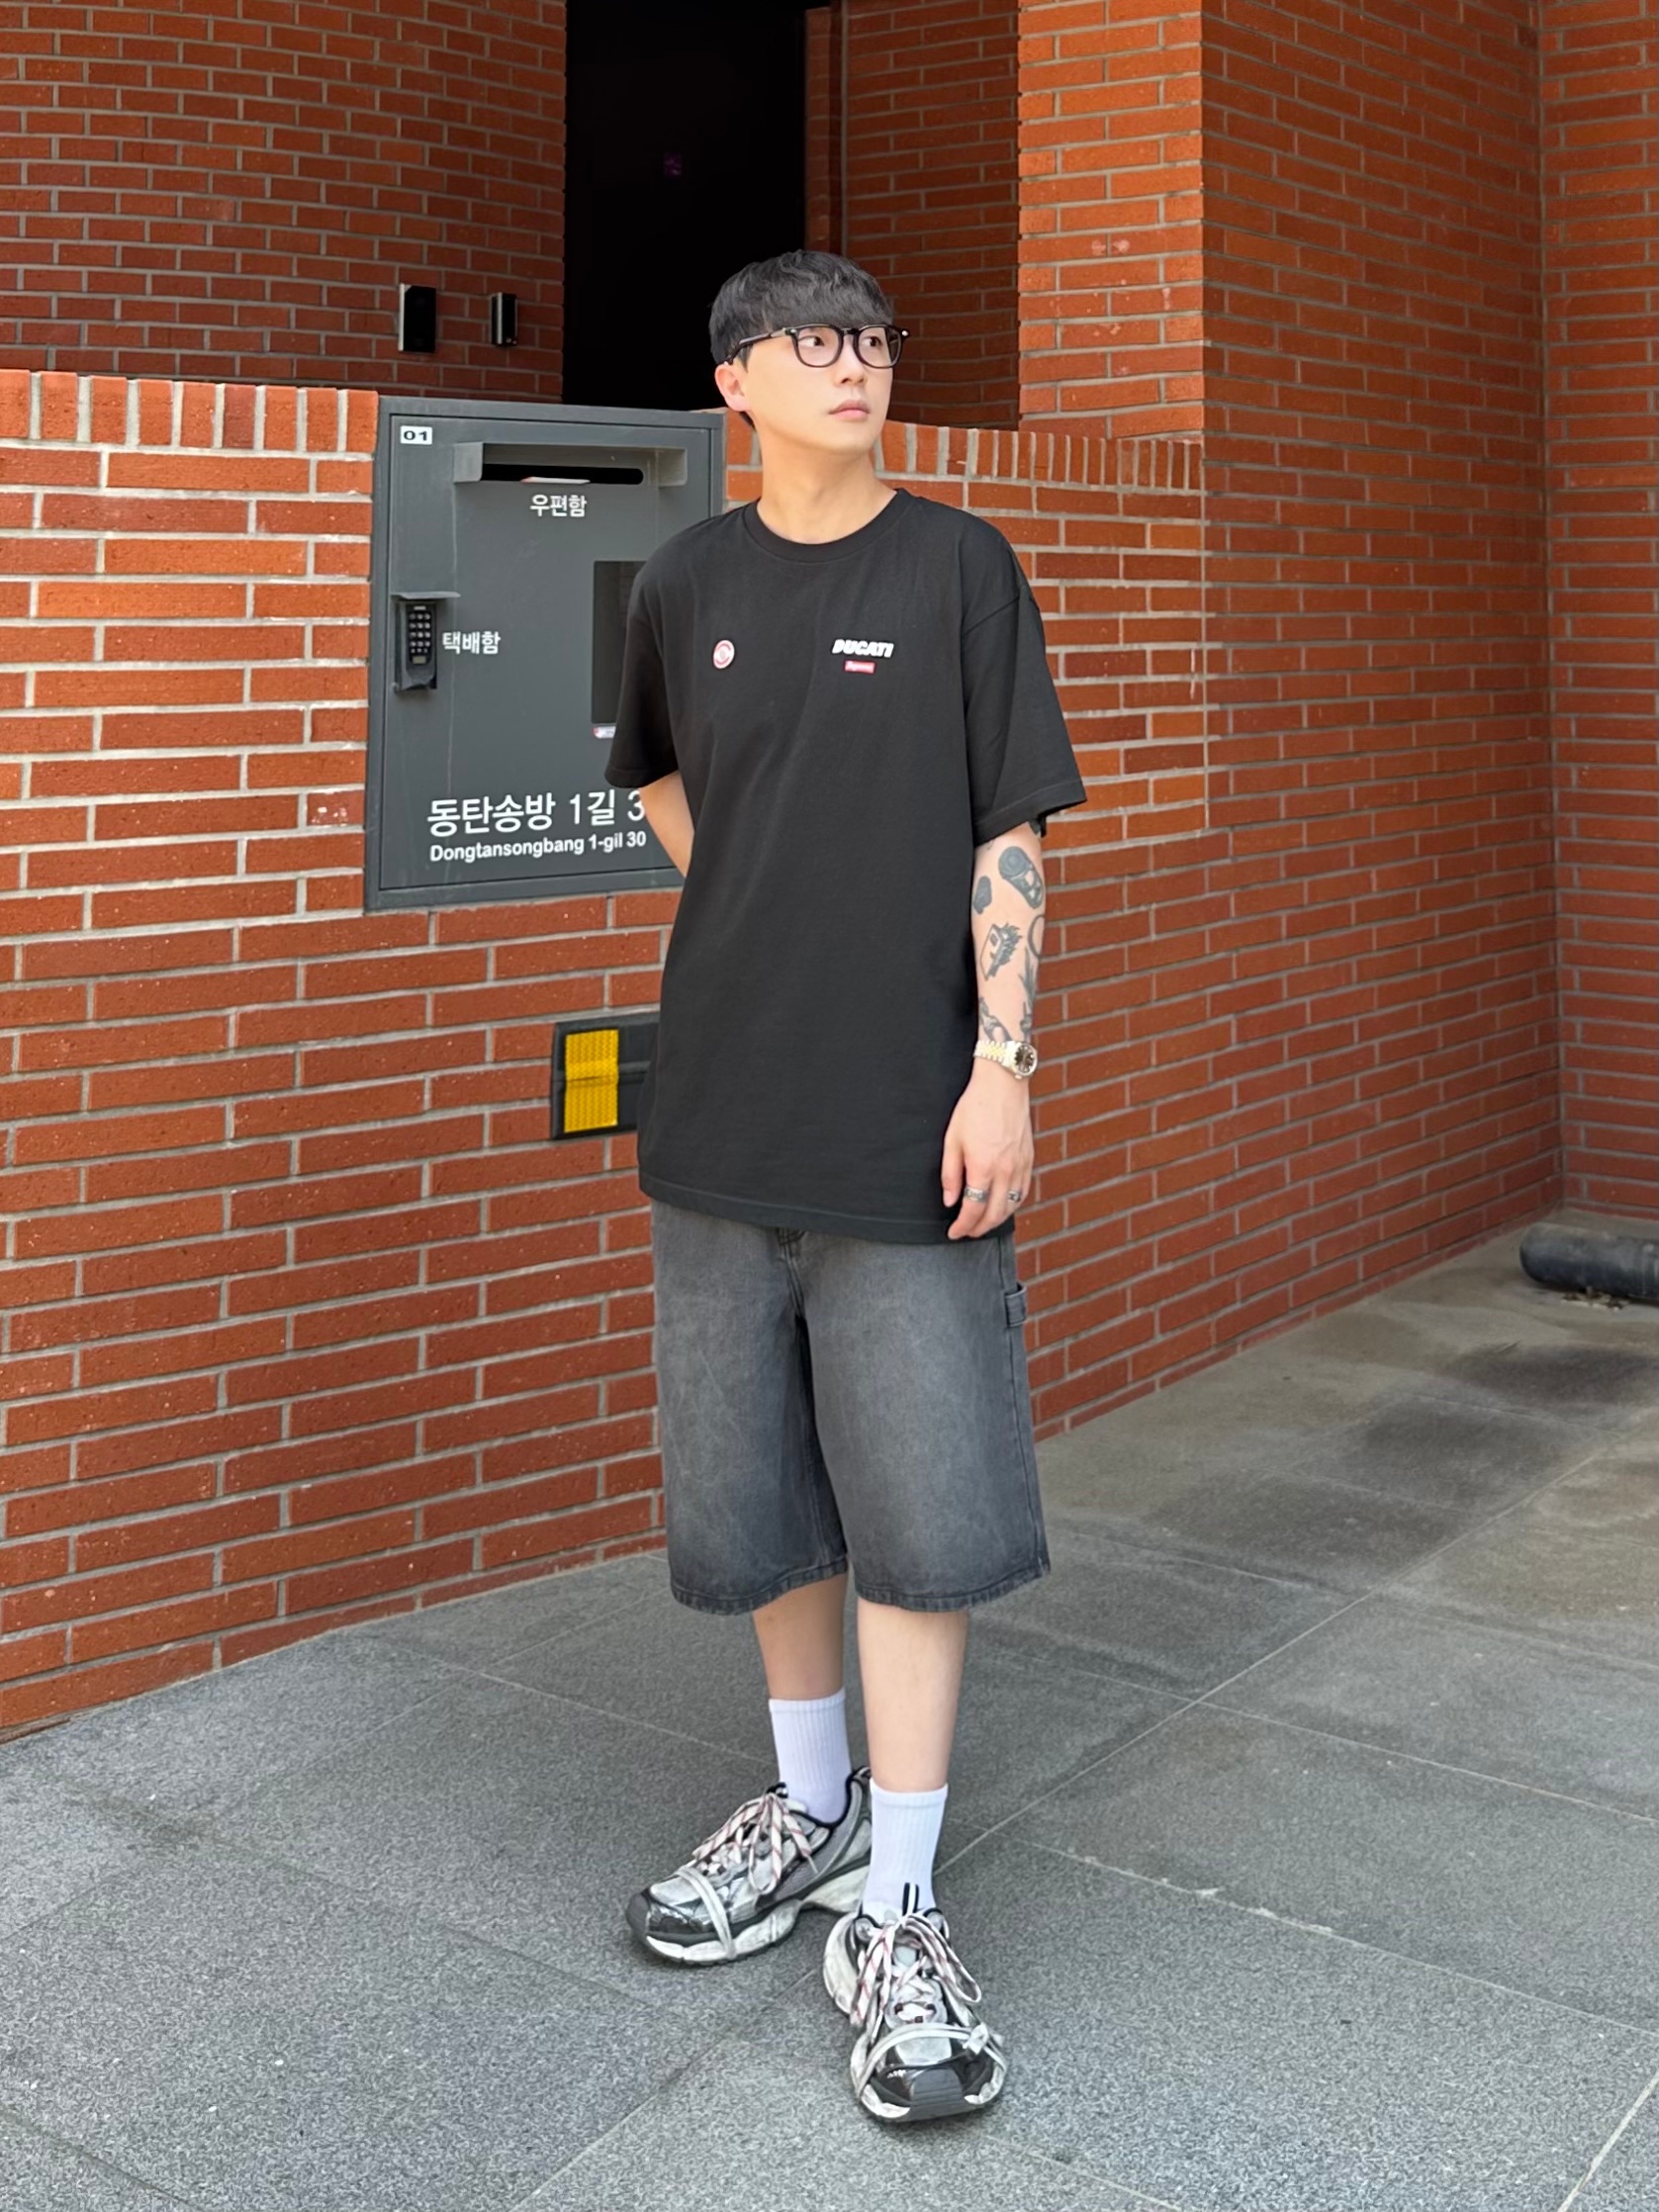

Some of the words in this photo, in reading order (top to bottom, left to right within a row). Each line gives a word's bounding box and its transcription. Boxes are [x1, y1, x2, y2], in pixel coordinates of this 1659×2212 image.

[404, 430, 427, 441] 01
[529, 494, 588, 517] 우편함
[442, 631, 502, 655] 택배함
[831, 638, 894, 659] DUCATI
[426, 791, 556, 838] 동탄송방
[569, 788, 615, 826] 1길
[627, 789, 646, 822] 3
[429, 836, 585, 864] Dongtansongbang
[588, 832, 623, 853] 1-gil
[626, 830, 647, 848] 30
